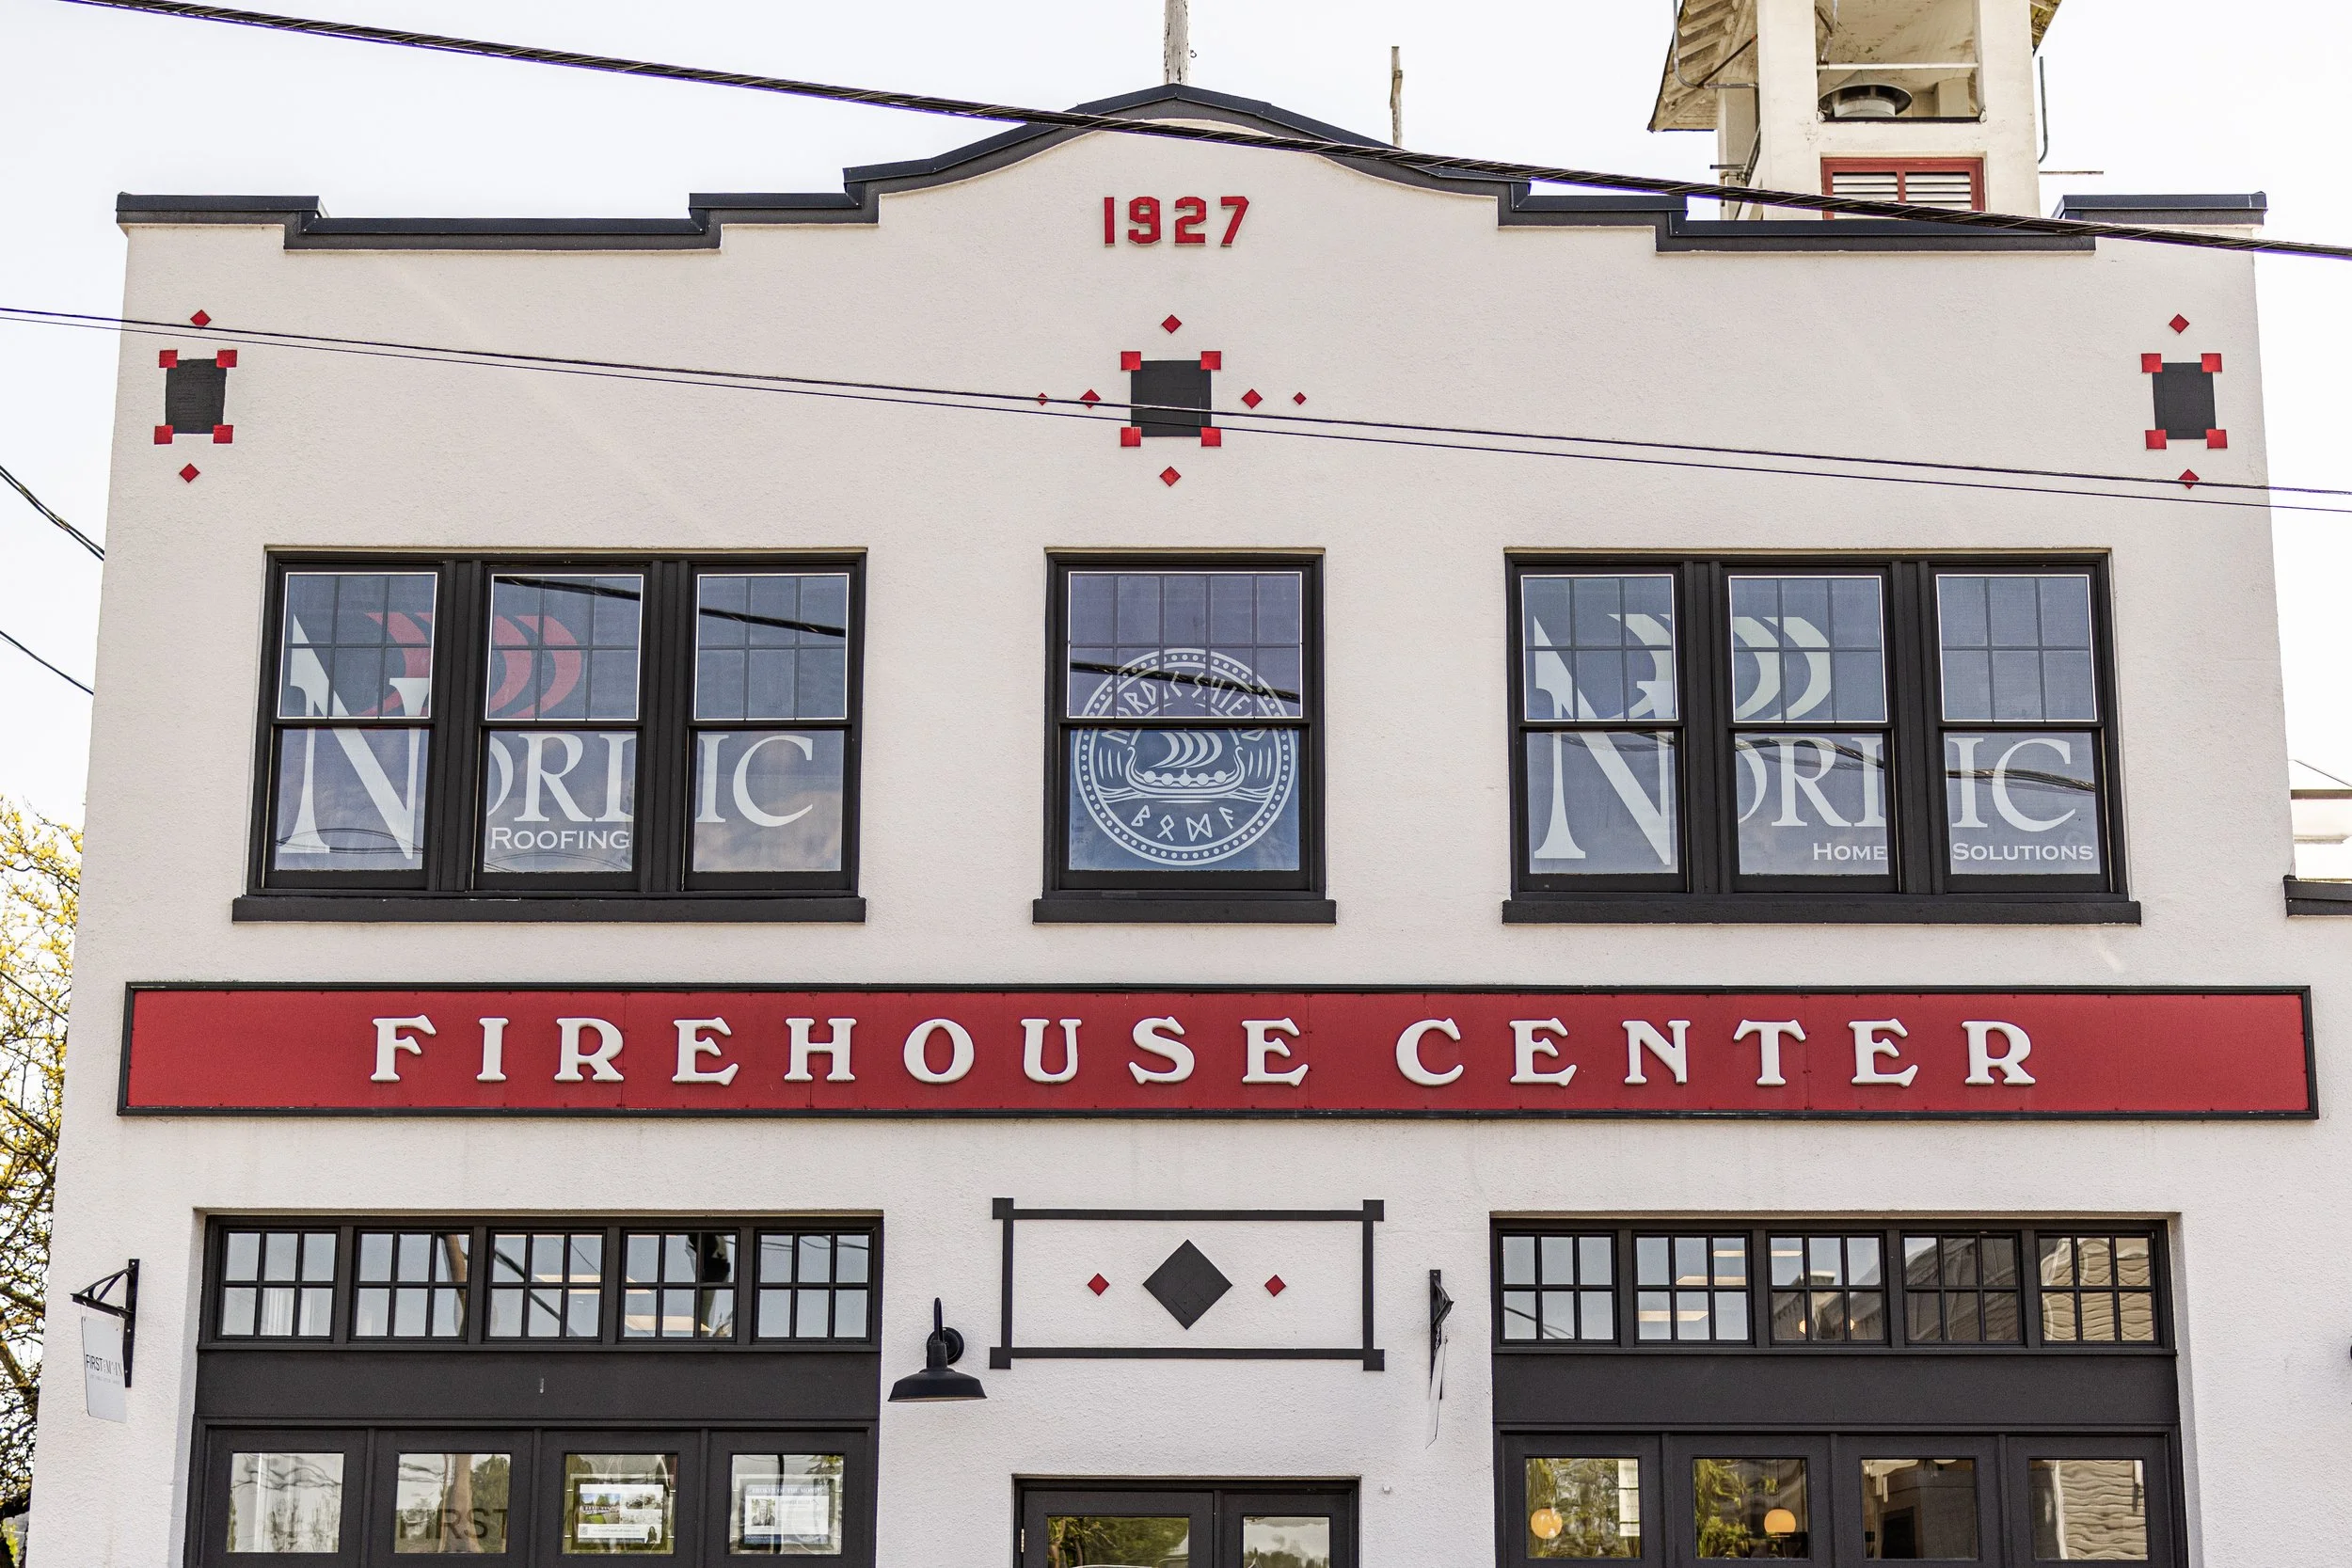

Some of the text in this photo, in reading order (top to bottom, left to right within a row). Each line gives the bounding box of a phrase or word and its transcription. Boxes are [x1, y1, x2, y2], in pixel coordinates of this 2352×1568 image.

[1104, 196, 1250, 246] 1927
[370, 1015, 2037, 1087] FIREHOUSE CENTER
[399, 1508, 507, 1540] FIRST
